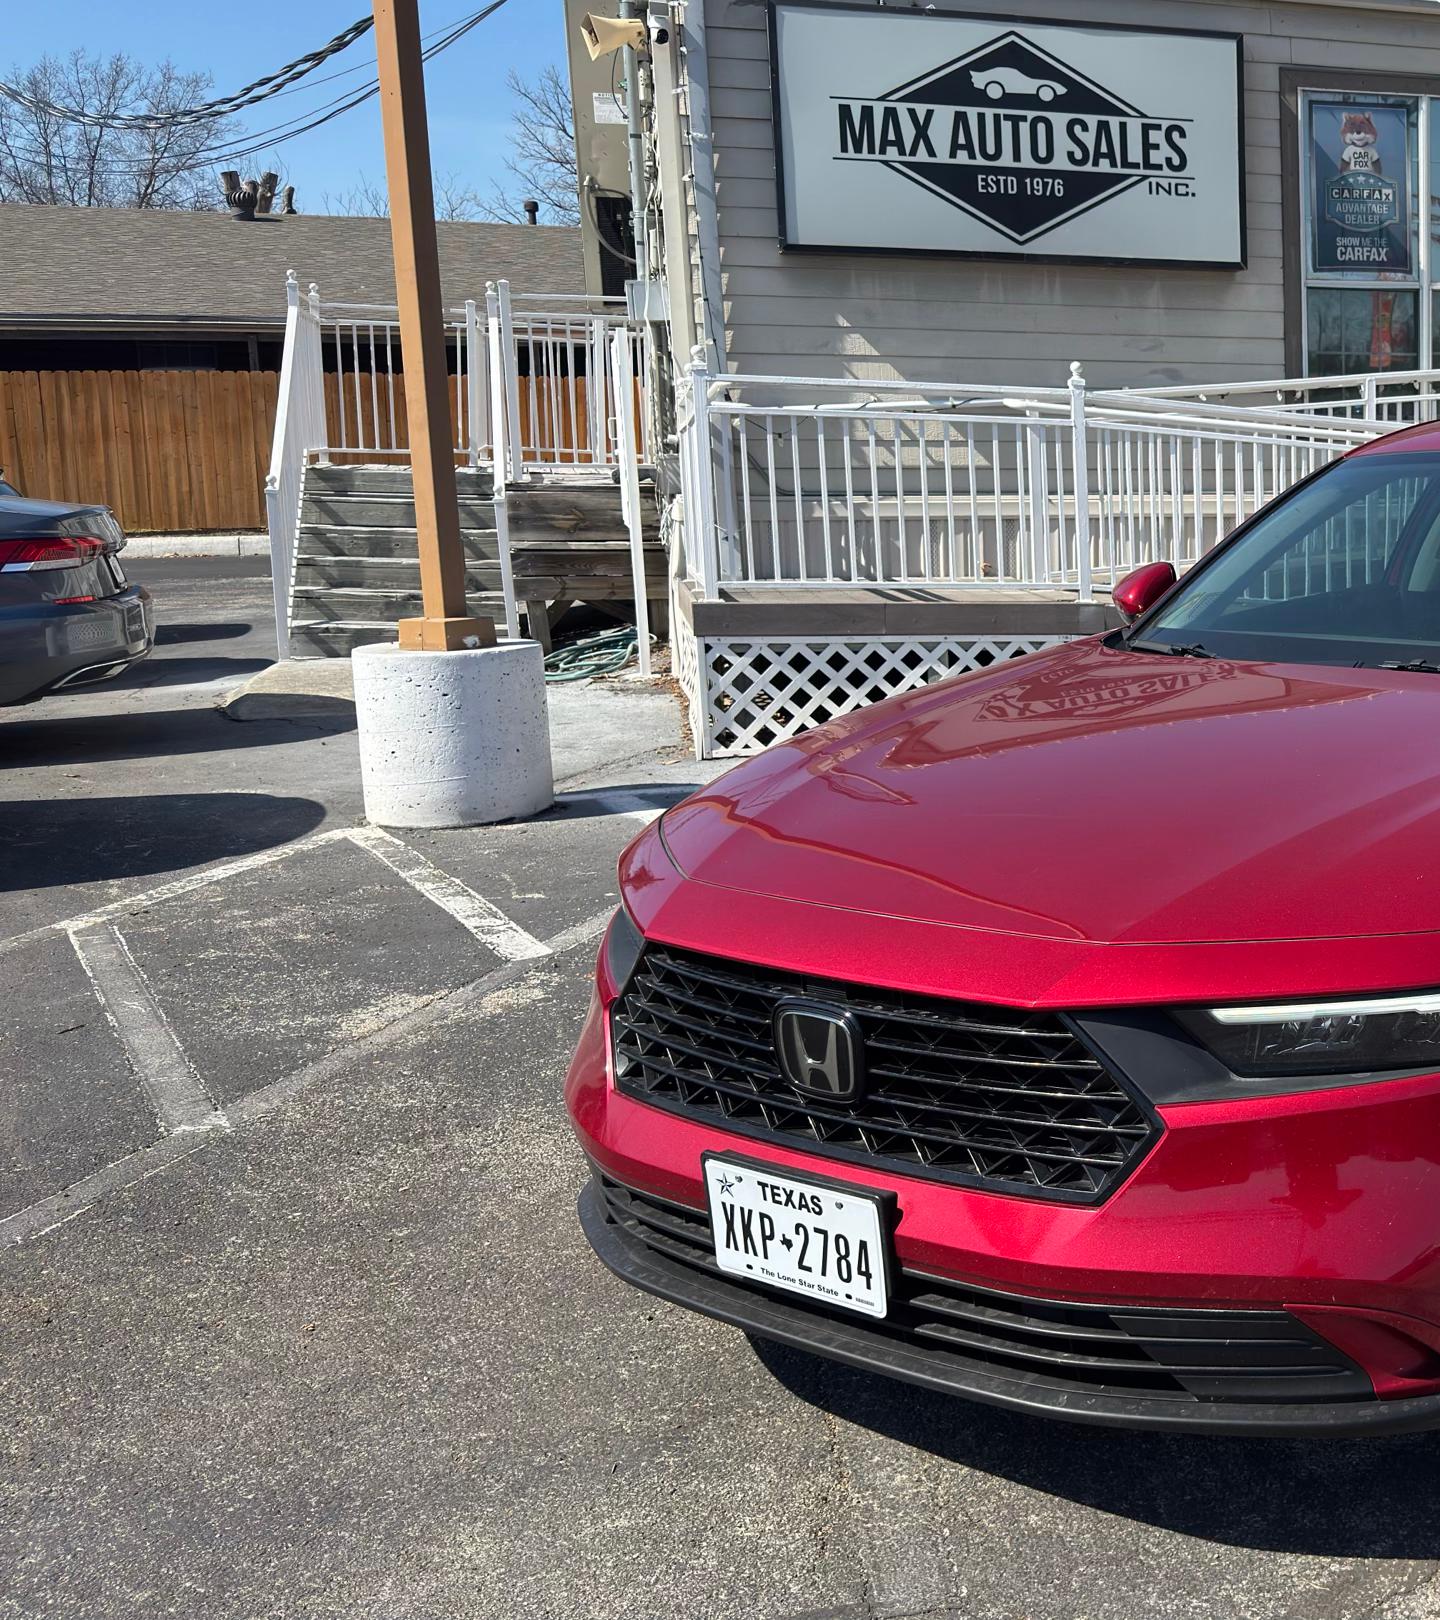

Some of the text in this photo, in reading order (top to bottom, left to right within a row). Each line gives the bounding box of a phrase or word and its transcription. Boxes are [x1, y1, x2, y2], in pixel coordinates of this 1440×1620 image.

[837, 103, 1188, 173] MAX AUTO SALES
[1352, 151, 1369, 160] CAR
[1353, 161, 1369, 169] FOX
[977, 174, 1064, 198] ESTD 1976
[1148, 180, 1196, 198] INC.
[1332, 188, 1392, 201] CARFAX
[1336, 202, 1389, 214] ADVANTAGE
[1345, 215, 1380, 224] DEALER
[1336, 237, 1387, 247] SHOW ME THE
[1337, 247, 1388, 262] CARFAX
[756, 1180, 824, 1216] TEXAS
[721, 1201, 873, 1291] XKP 2784
[760, 1267, 839, 1297] The Lone Star State
